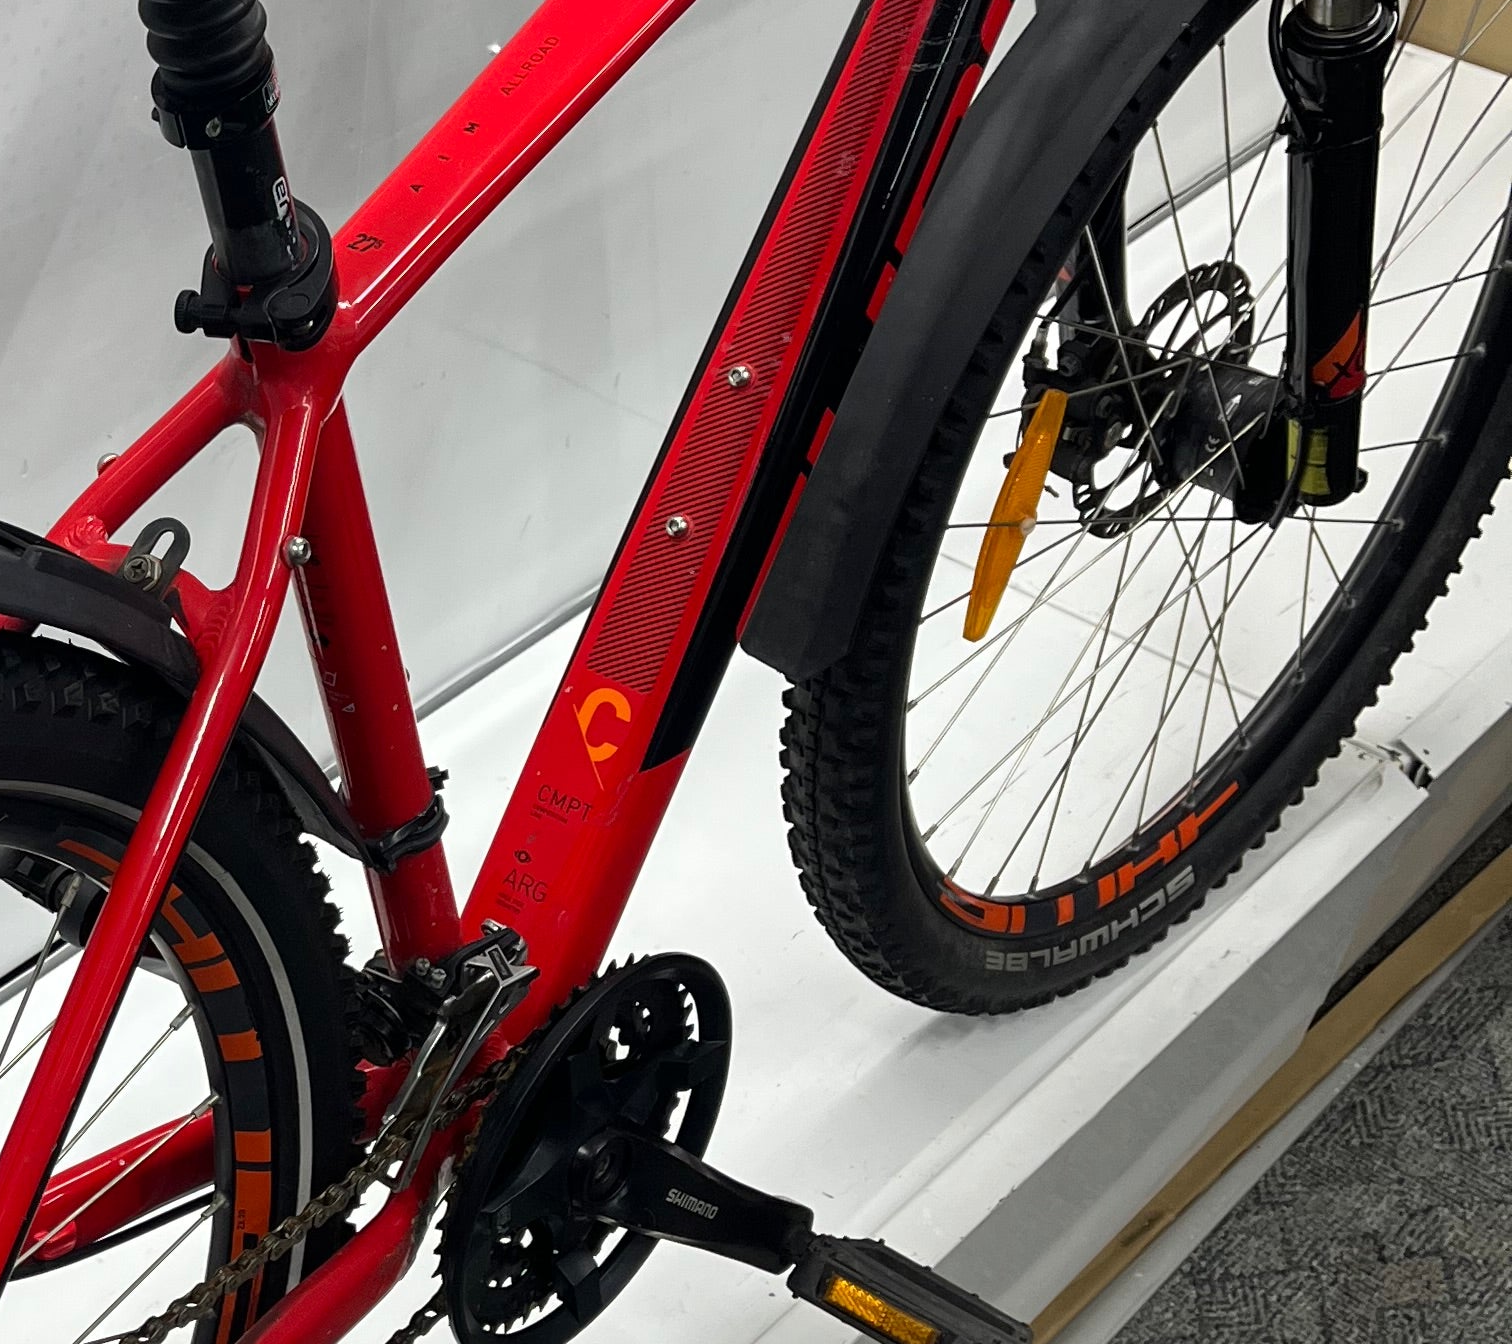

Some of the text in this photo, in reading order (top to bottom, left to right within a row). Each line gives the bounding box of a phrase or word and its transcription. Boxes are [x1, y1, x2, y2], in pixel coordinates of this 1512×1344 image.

[500, 35, 559, 97] ALLROAD
[537, 783, 593, 823] CMPT
[502, 867, 549, 904] ARG
[985, 864, 1196, 972] SCHWALBE
[665, 1187, 719, 1220] SHIMANO
